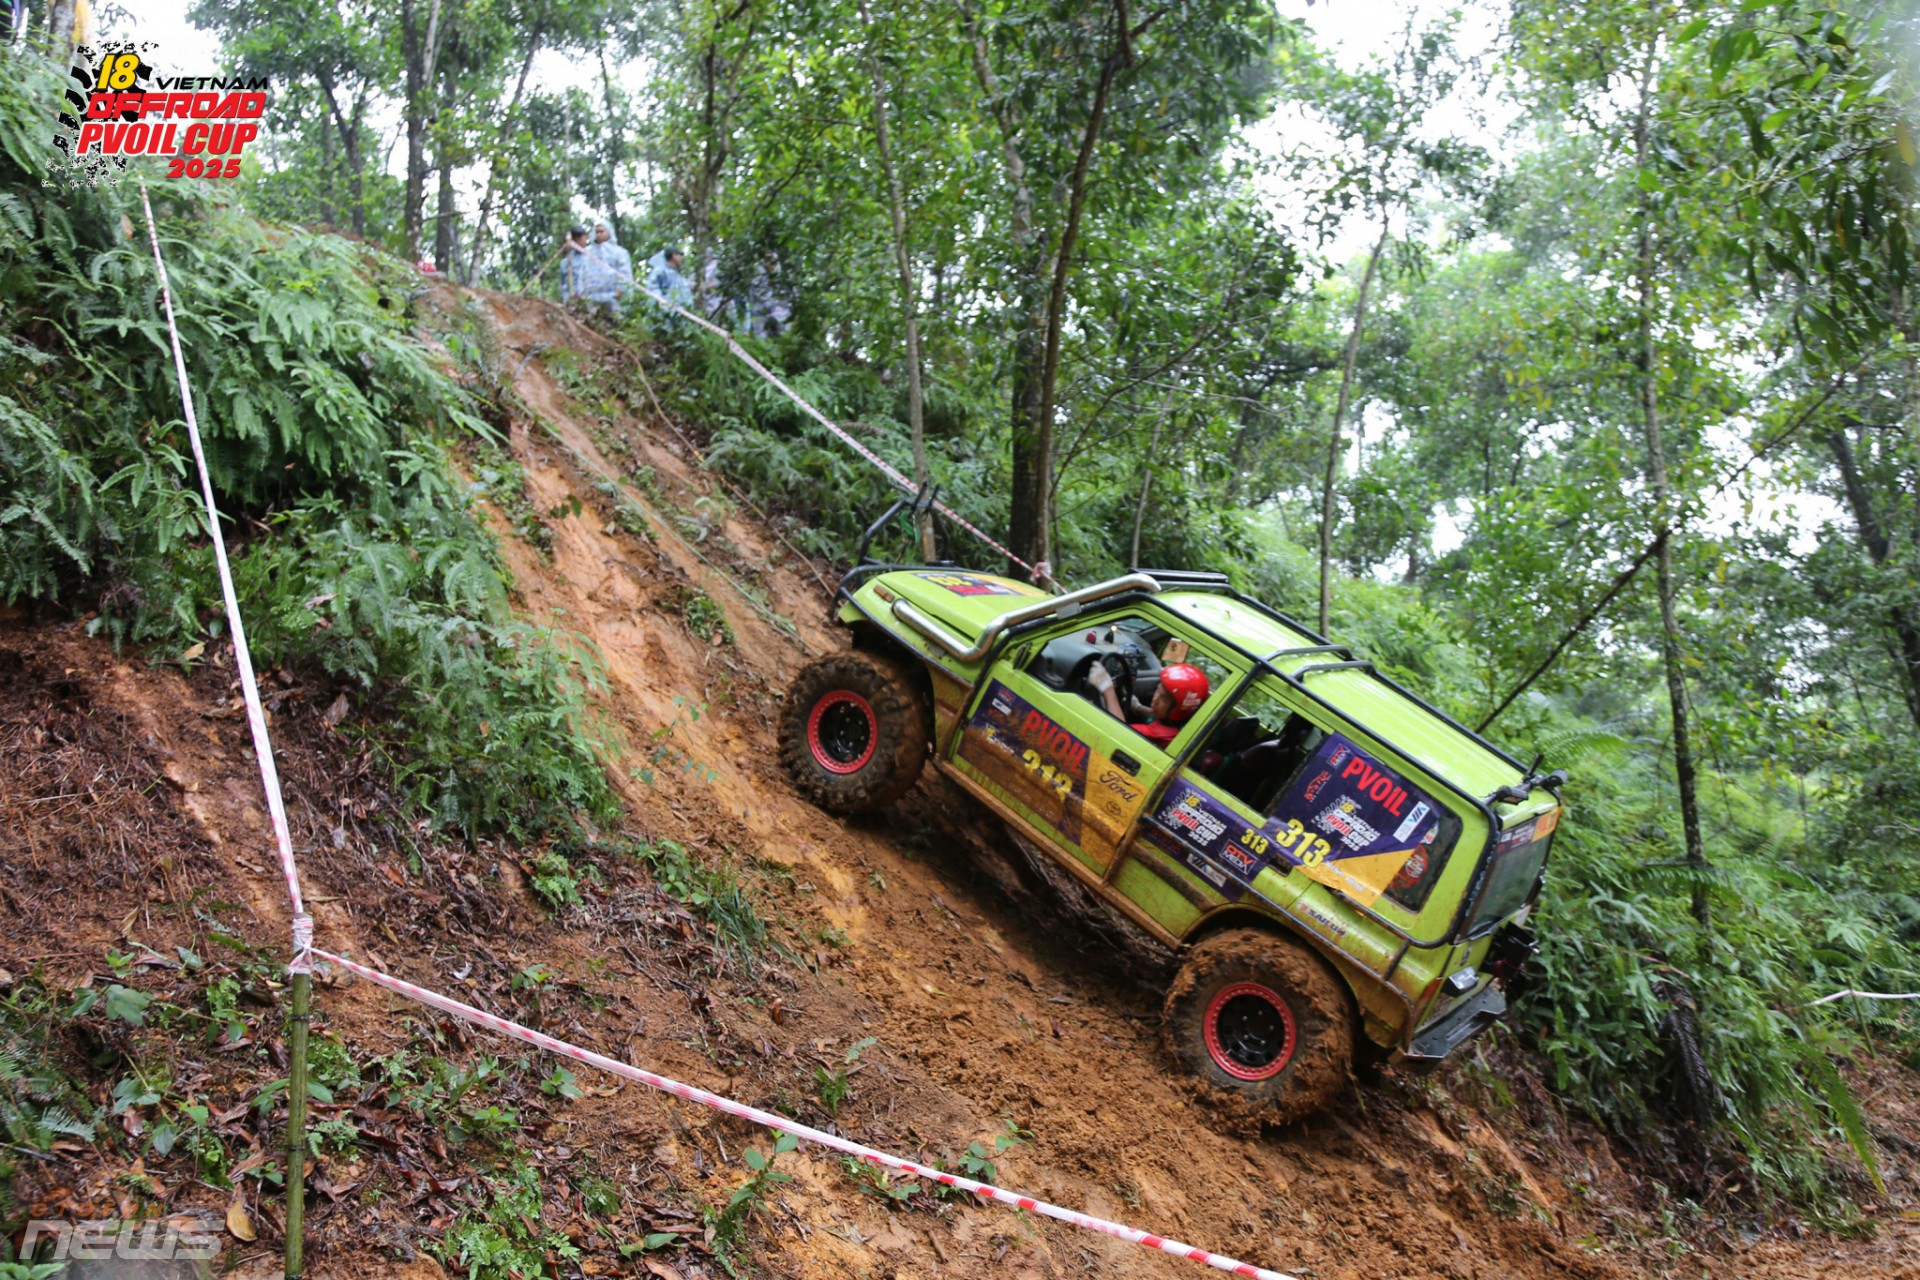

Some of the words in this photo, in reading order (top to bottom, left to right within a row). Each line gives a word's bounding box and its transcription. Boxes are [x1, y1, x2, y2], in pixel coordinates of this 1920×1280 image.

[1021, 709, 1084, 776] PVOIL
[1099, 770, 1138, 803] Ford
[1341, 757, 1409, 817] PVOIL
[1171, 808, 1199, 831] PVOIL
[1195, 825, 1218, 841] CUP
[1187, 831, 1209, 846] 2025
[1241, 828, 1269, 854] 313
[1348, 830, 1371, 847] CUP
[1226, 844, 1254, 865] OTV
[1276, 818, 1331, 868] 313
